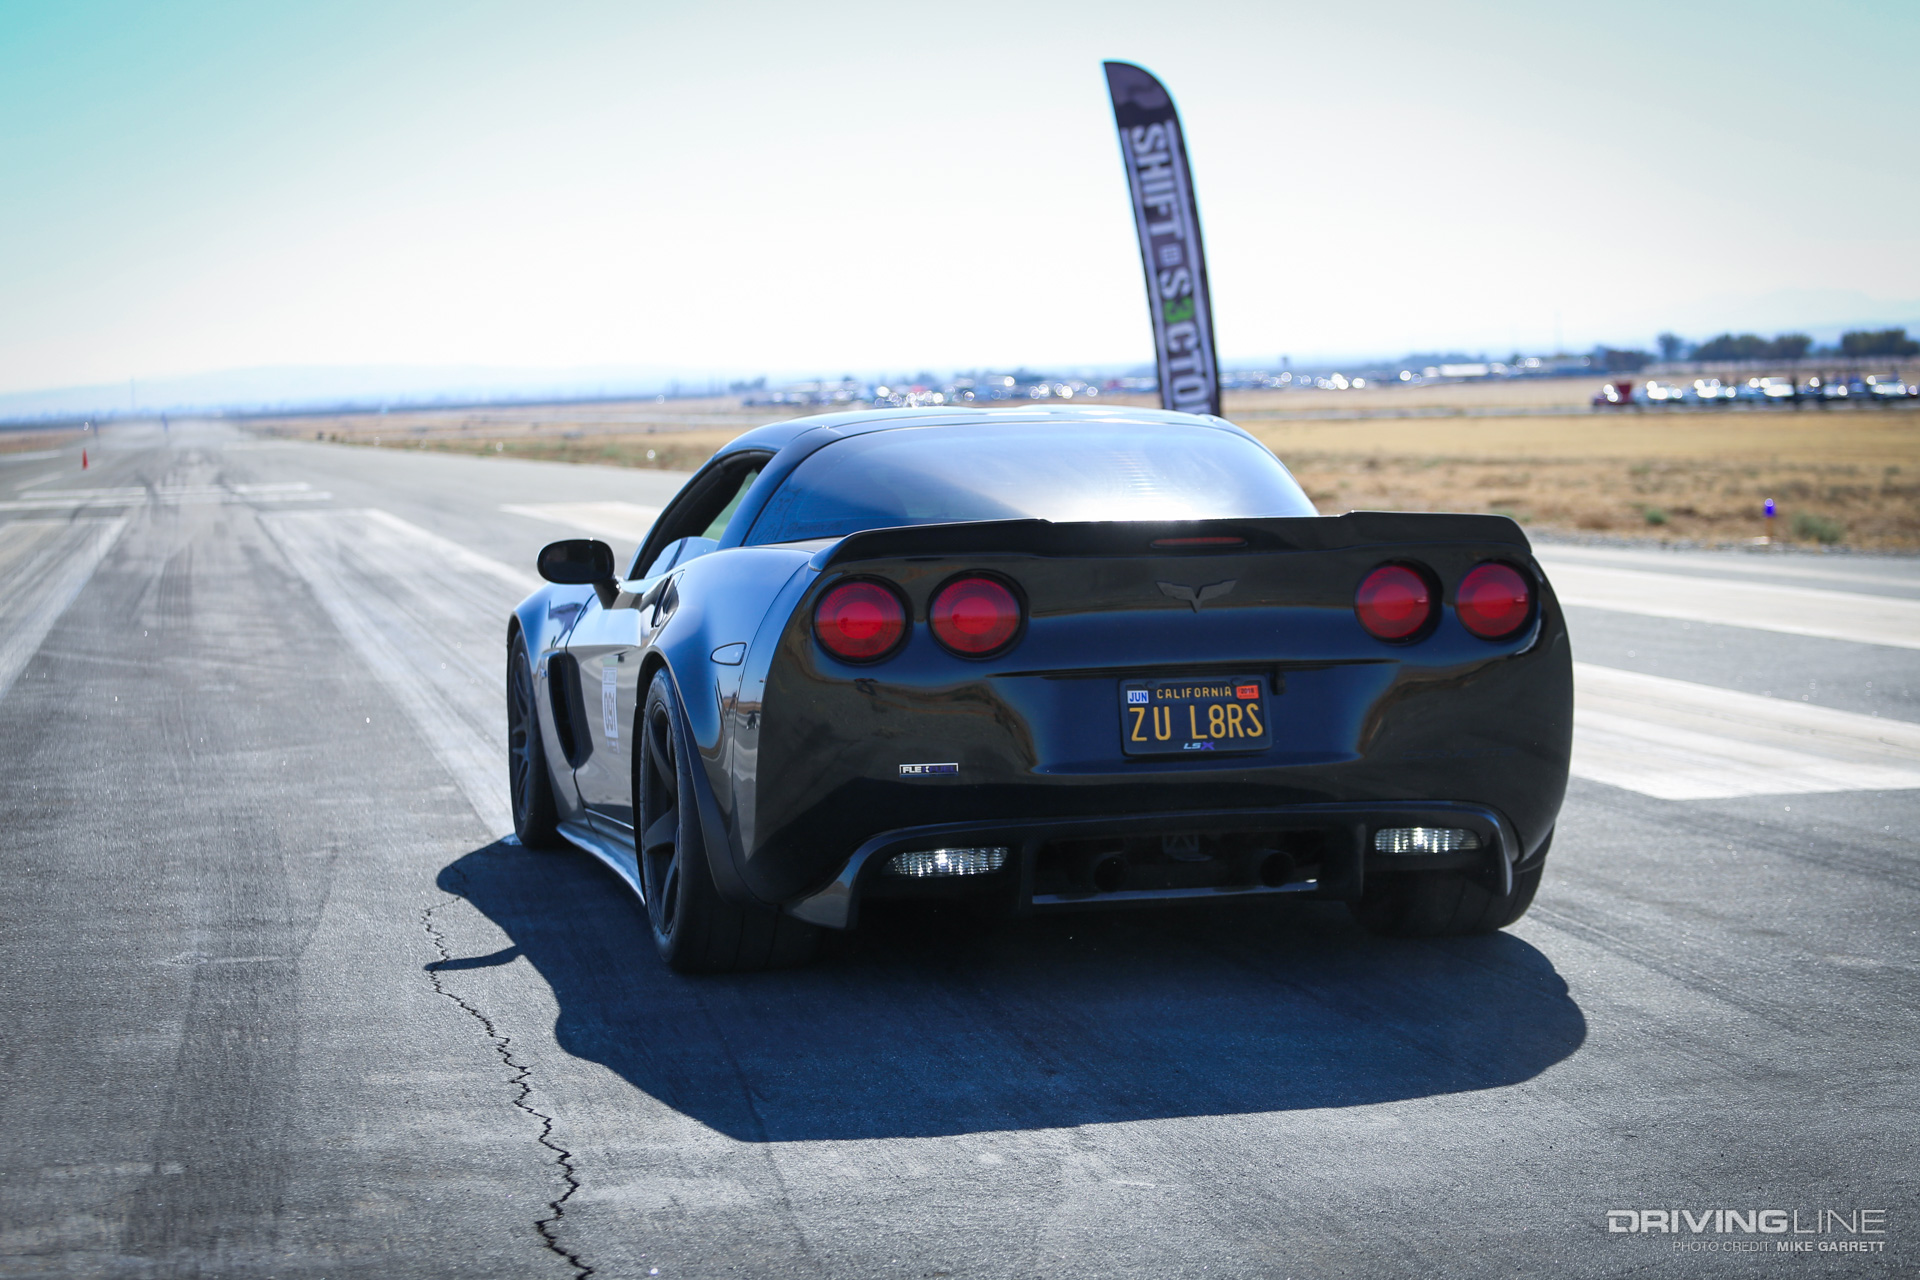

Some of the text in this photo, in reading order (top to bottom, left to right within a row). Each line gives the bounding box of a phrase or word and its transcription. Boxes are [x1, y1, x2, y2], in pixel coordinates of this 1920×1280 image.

[1131, 122, 1184, 241] SHIFT
[1129, 692, 1148, 702] JUN
[1156, 686, 1232, 699] CALIFORNIA
[1129, 703, 1264, 742] ZU L8RS
[1183, 741, 1215, 750] LSX
